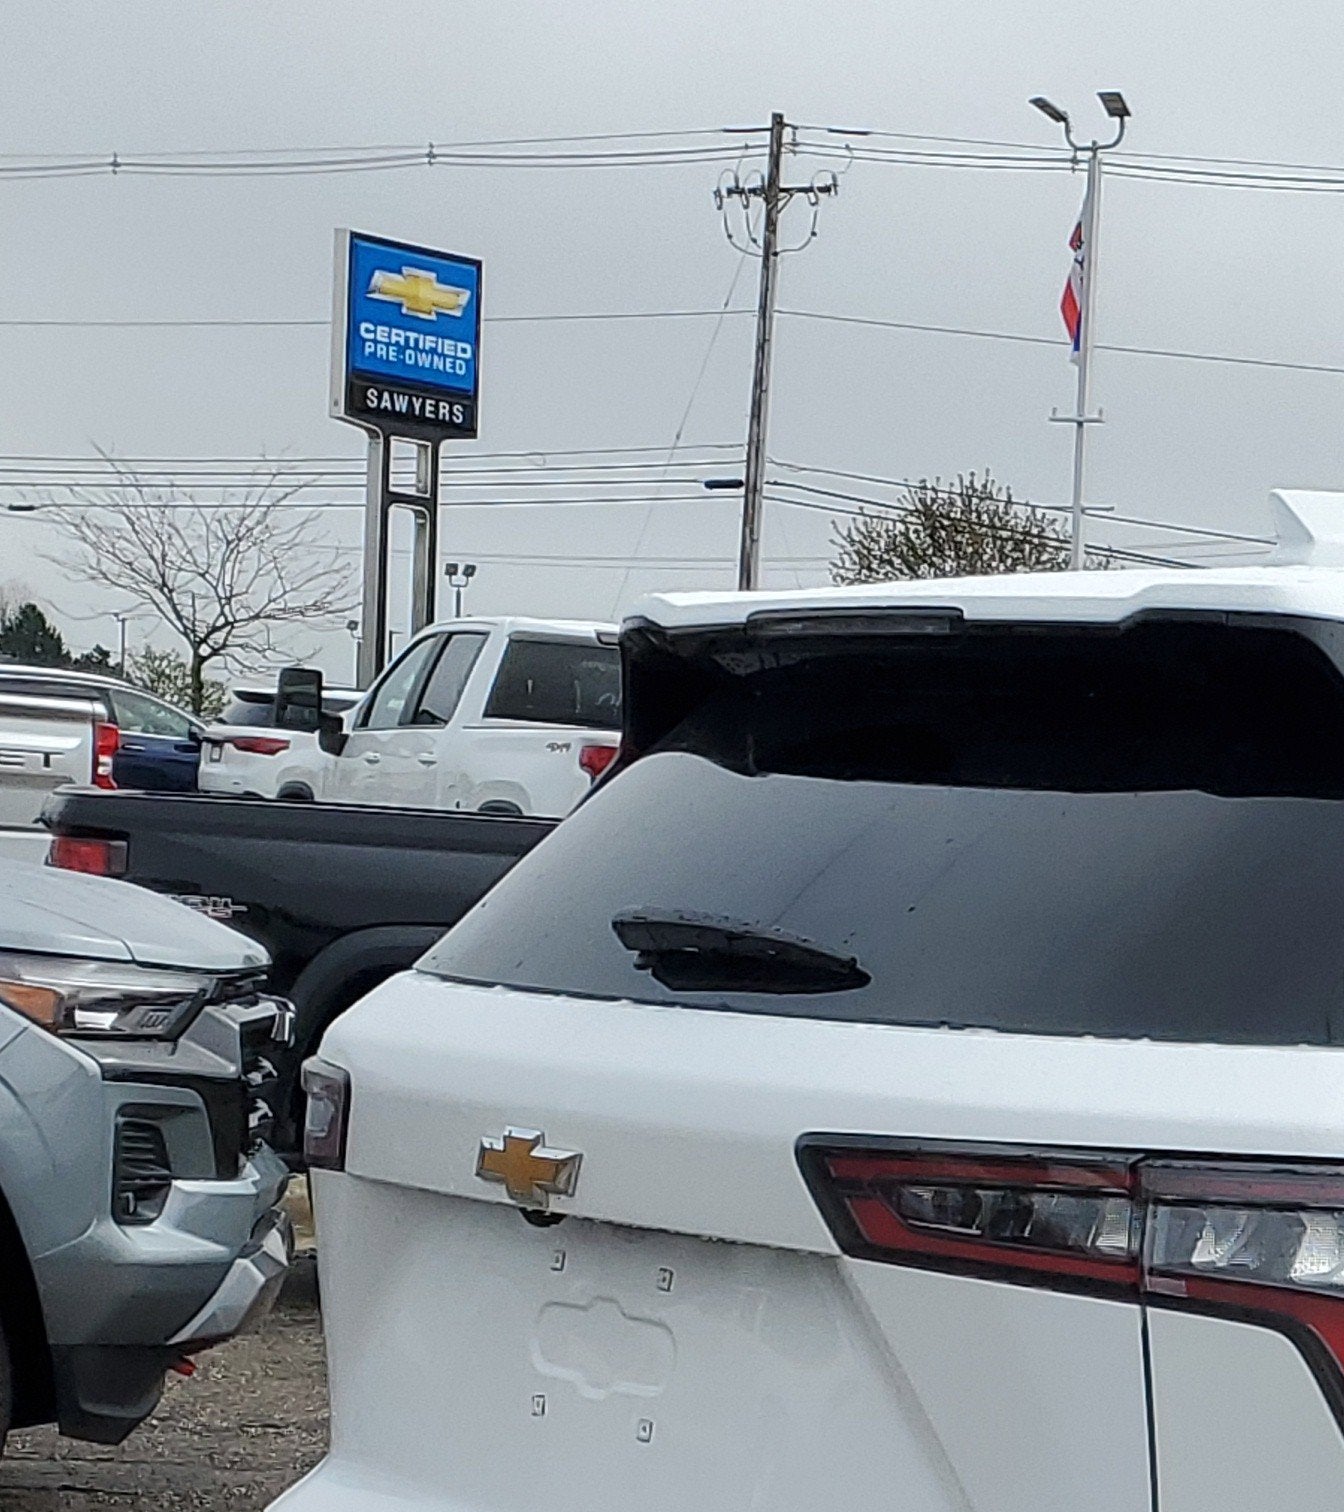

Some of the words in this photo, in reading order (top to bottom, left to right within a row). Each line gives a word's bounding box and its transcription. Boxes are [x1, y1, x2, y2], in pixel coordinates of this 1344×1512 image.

[360, 322, 472, 358] CERTIFIED
[363, 342, 466, 375] PRE-OWNED
[366, 388, 463, 423] SAWYERS
